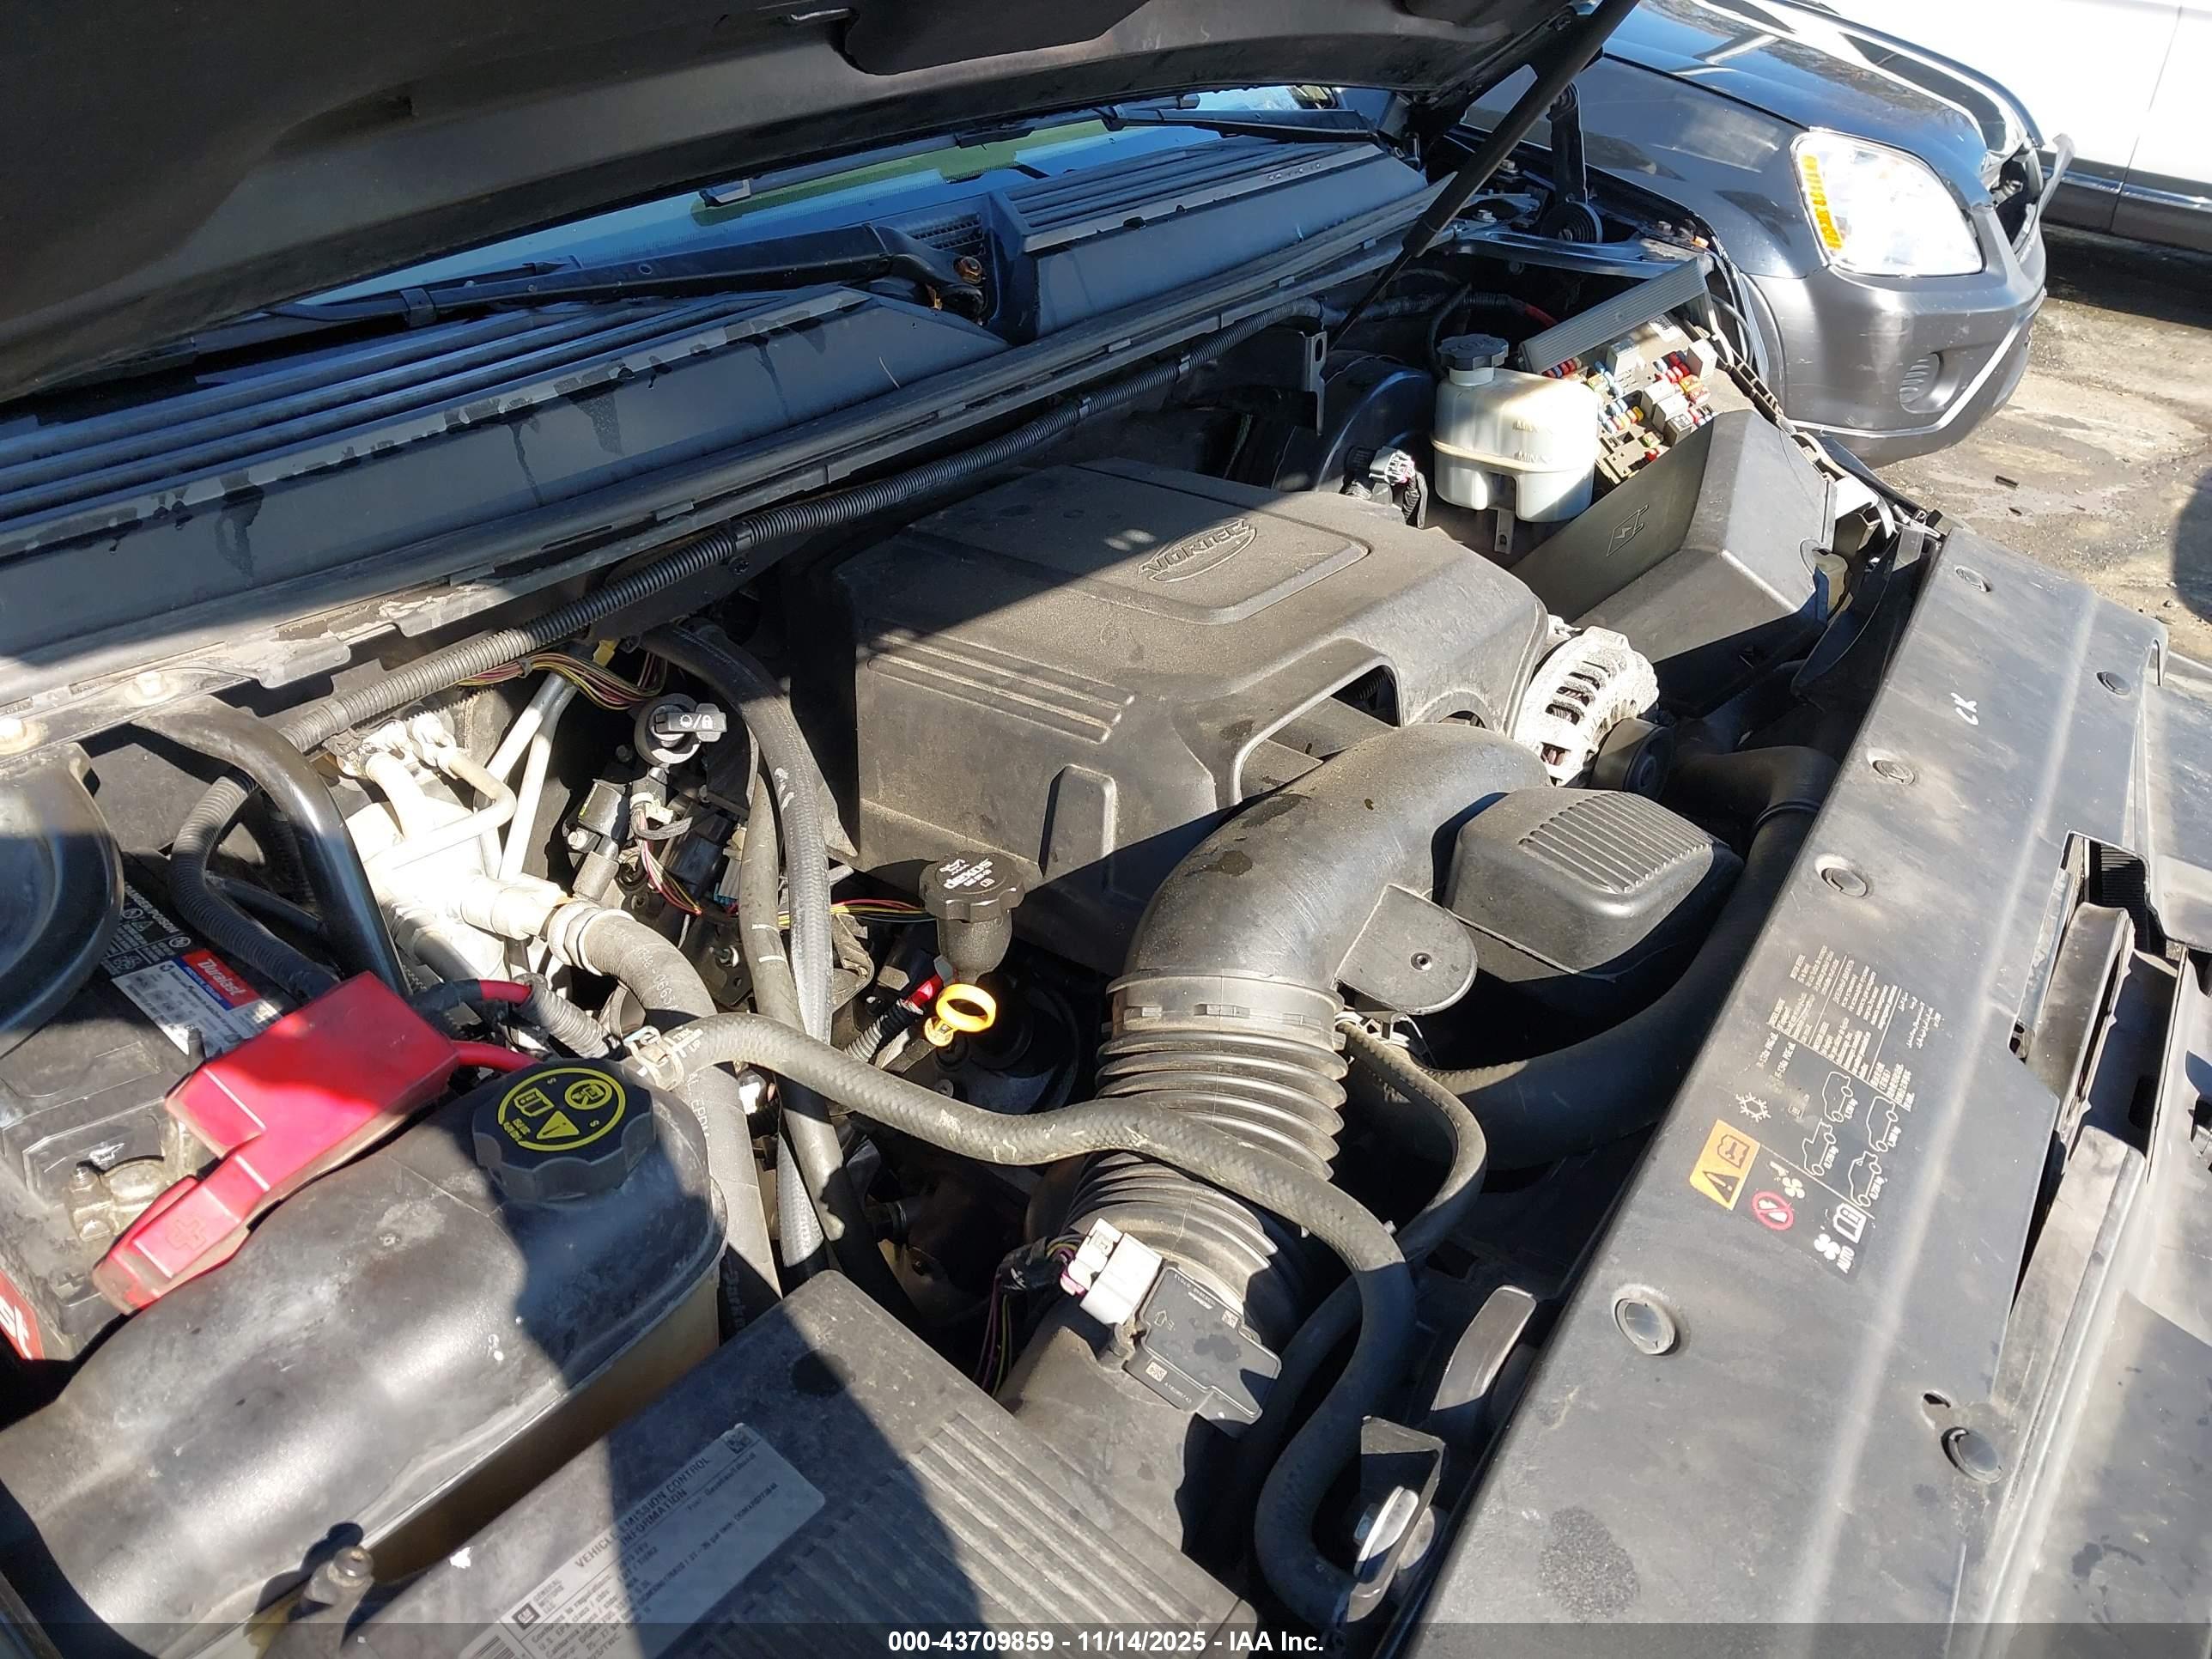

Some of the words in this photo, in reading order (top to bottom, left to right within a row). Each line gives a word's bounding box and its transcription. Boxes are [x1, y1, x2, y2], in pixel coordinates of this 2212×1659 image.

[1139, 519, 1252, 576] VORTEC
[198, 958, 246, 996] Duralast
[1836, 1249, 1856, 1274] AUTO
[574, 1528, 620, 1569] VEHICLE
[618, 1489, 668, 1532] EMISSION
[665, 1454, 710, 1494] CONTROL
[618, 1487, 689, 1547] INFORMATION
